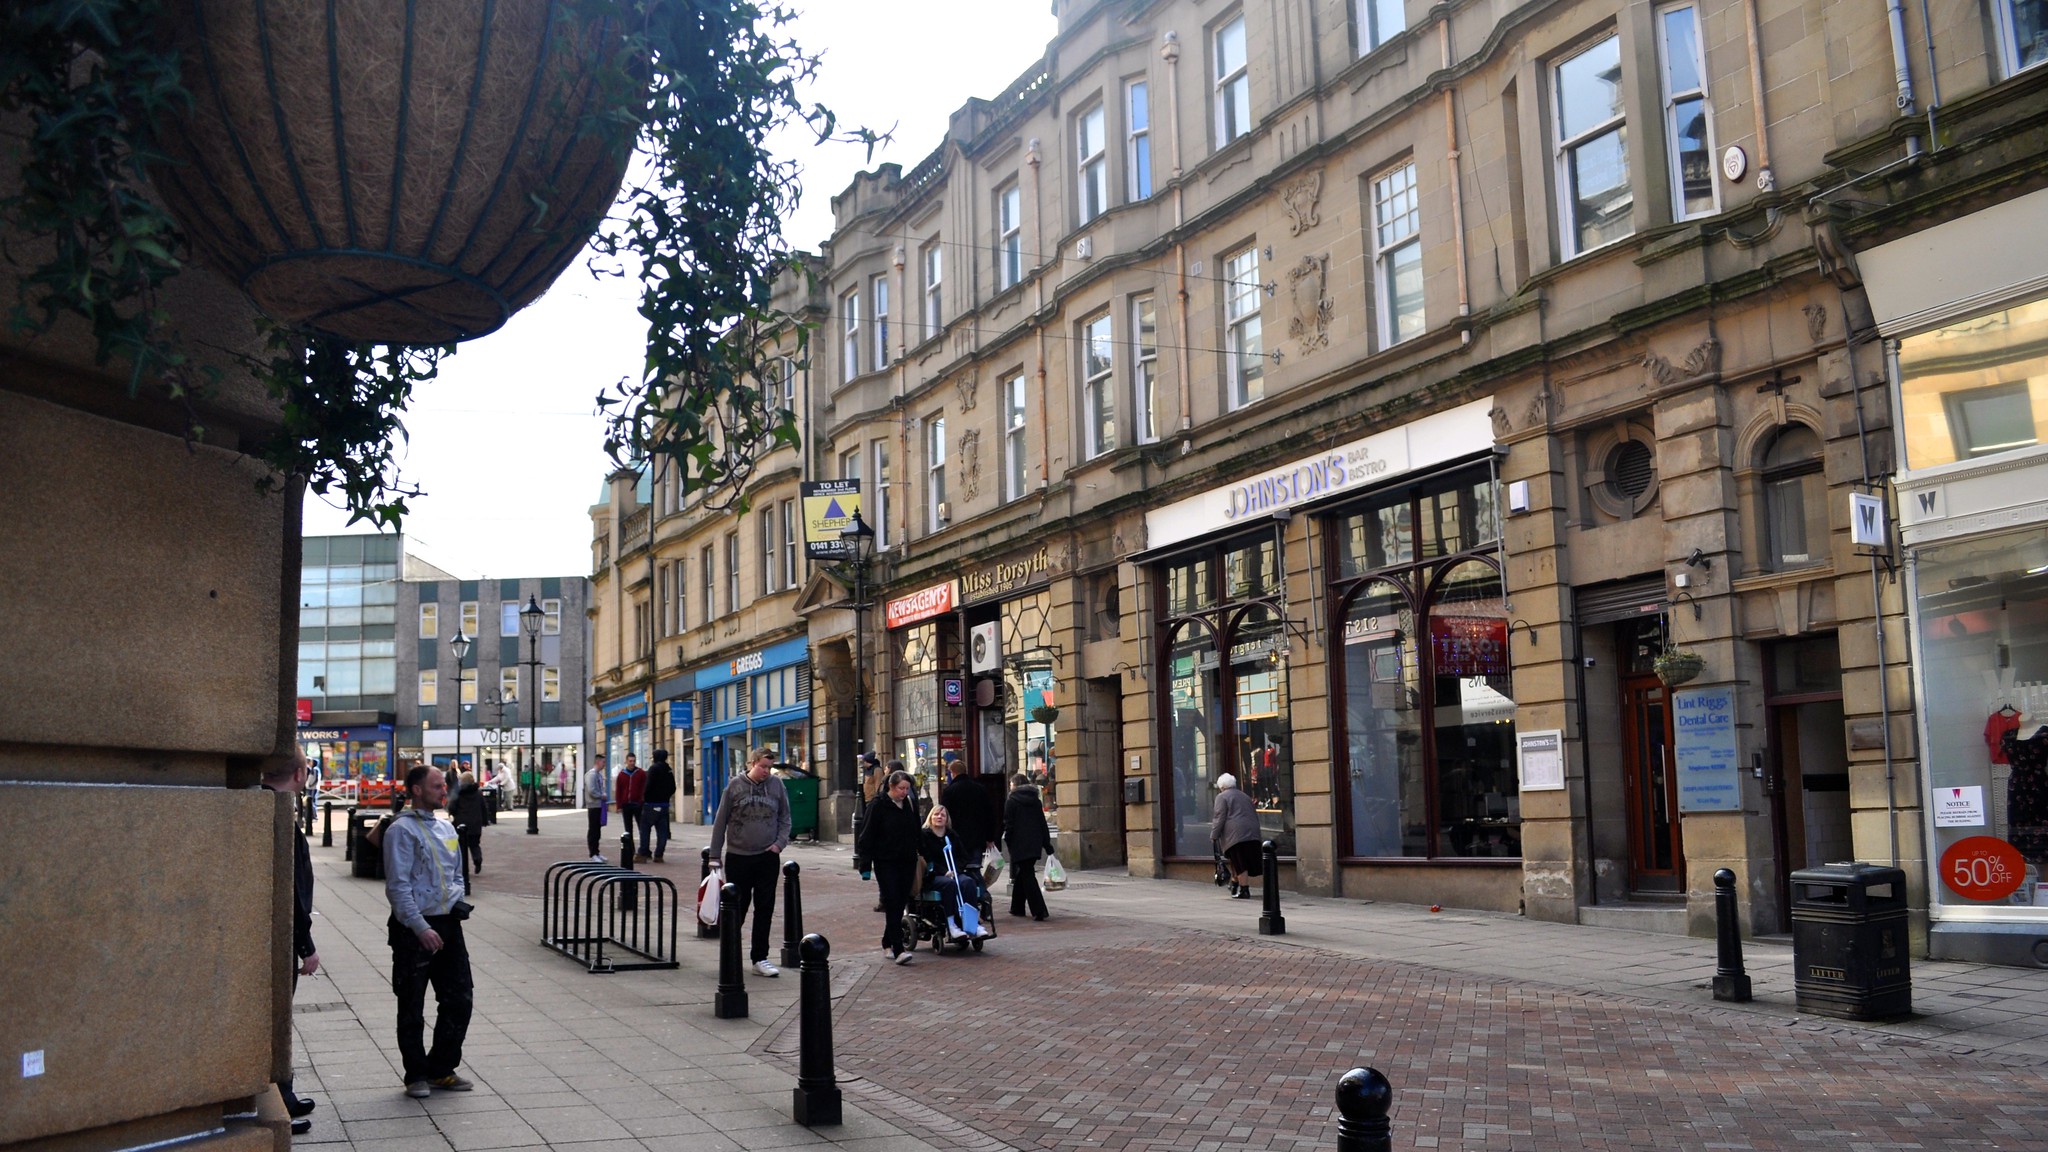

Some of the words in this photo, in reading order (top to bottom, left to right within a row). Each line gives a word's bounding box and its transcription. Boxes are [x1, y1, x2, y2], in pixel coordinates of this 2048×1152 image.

[1347, 447, 1369, 464] BAR
[1349, 459, 1387, 482] BISTRO
[1224, 454, 1346, 519] JOHNSTON'S
[1918, 491, 1937, 515] W
[812, 517, 851, 529] SHEPHER
[1860, 504, 1876, 536] W
[810, 541, 828, 550] 0141
[830, 540, 844, 549] 331
[961, 570, 992, 595] Miss
[996, 547, 1049, 586] Forsyth
[969, 587, 1000, 601] established
[888, 585, 948, 619] NEWSAGENTS
[736, 651, 763, 675] GREGGS
[1678, 698, 1695, 710] Lint
[1698, 696, 1728, 710] Riggs
[1679, 713, 1707, 726] Dental
[1708, 713, 1729, 724] Care
[302, 731, 340, 740] WORKS
[480, 730, 525, 744] VOGUE
[1954, 856, 2005, 887] 50%
[1990, 872, 2012, 884] OFF
[1811, 968, 1844, 979] LITTER
